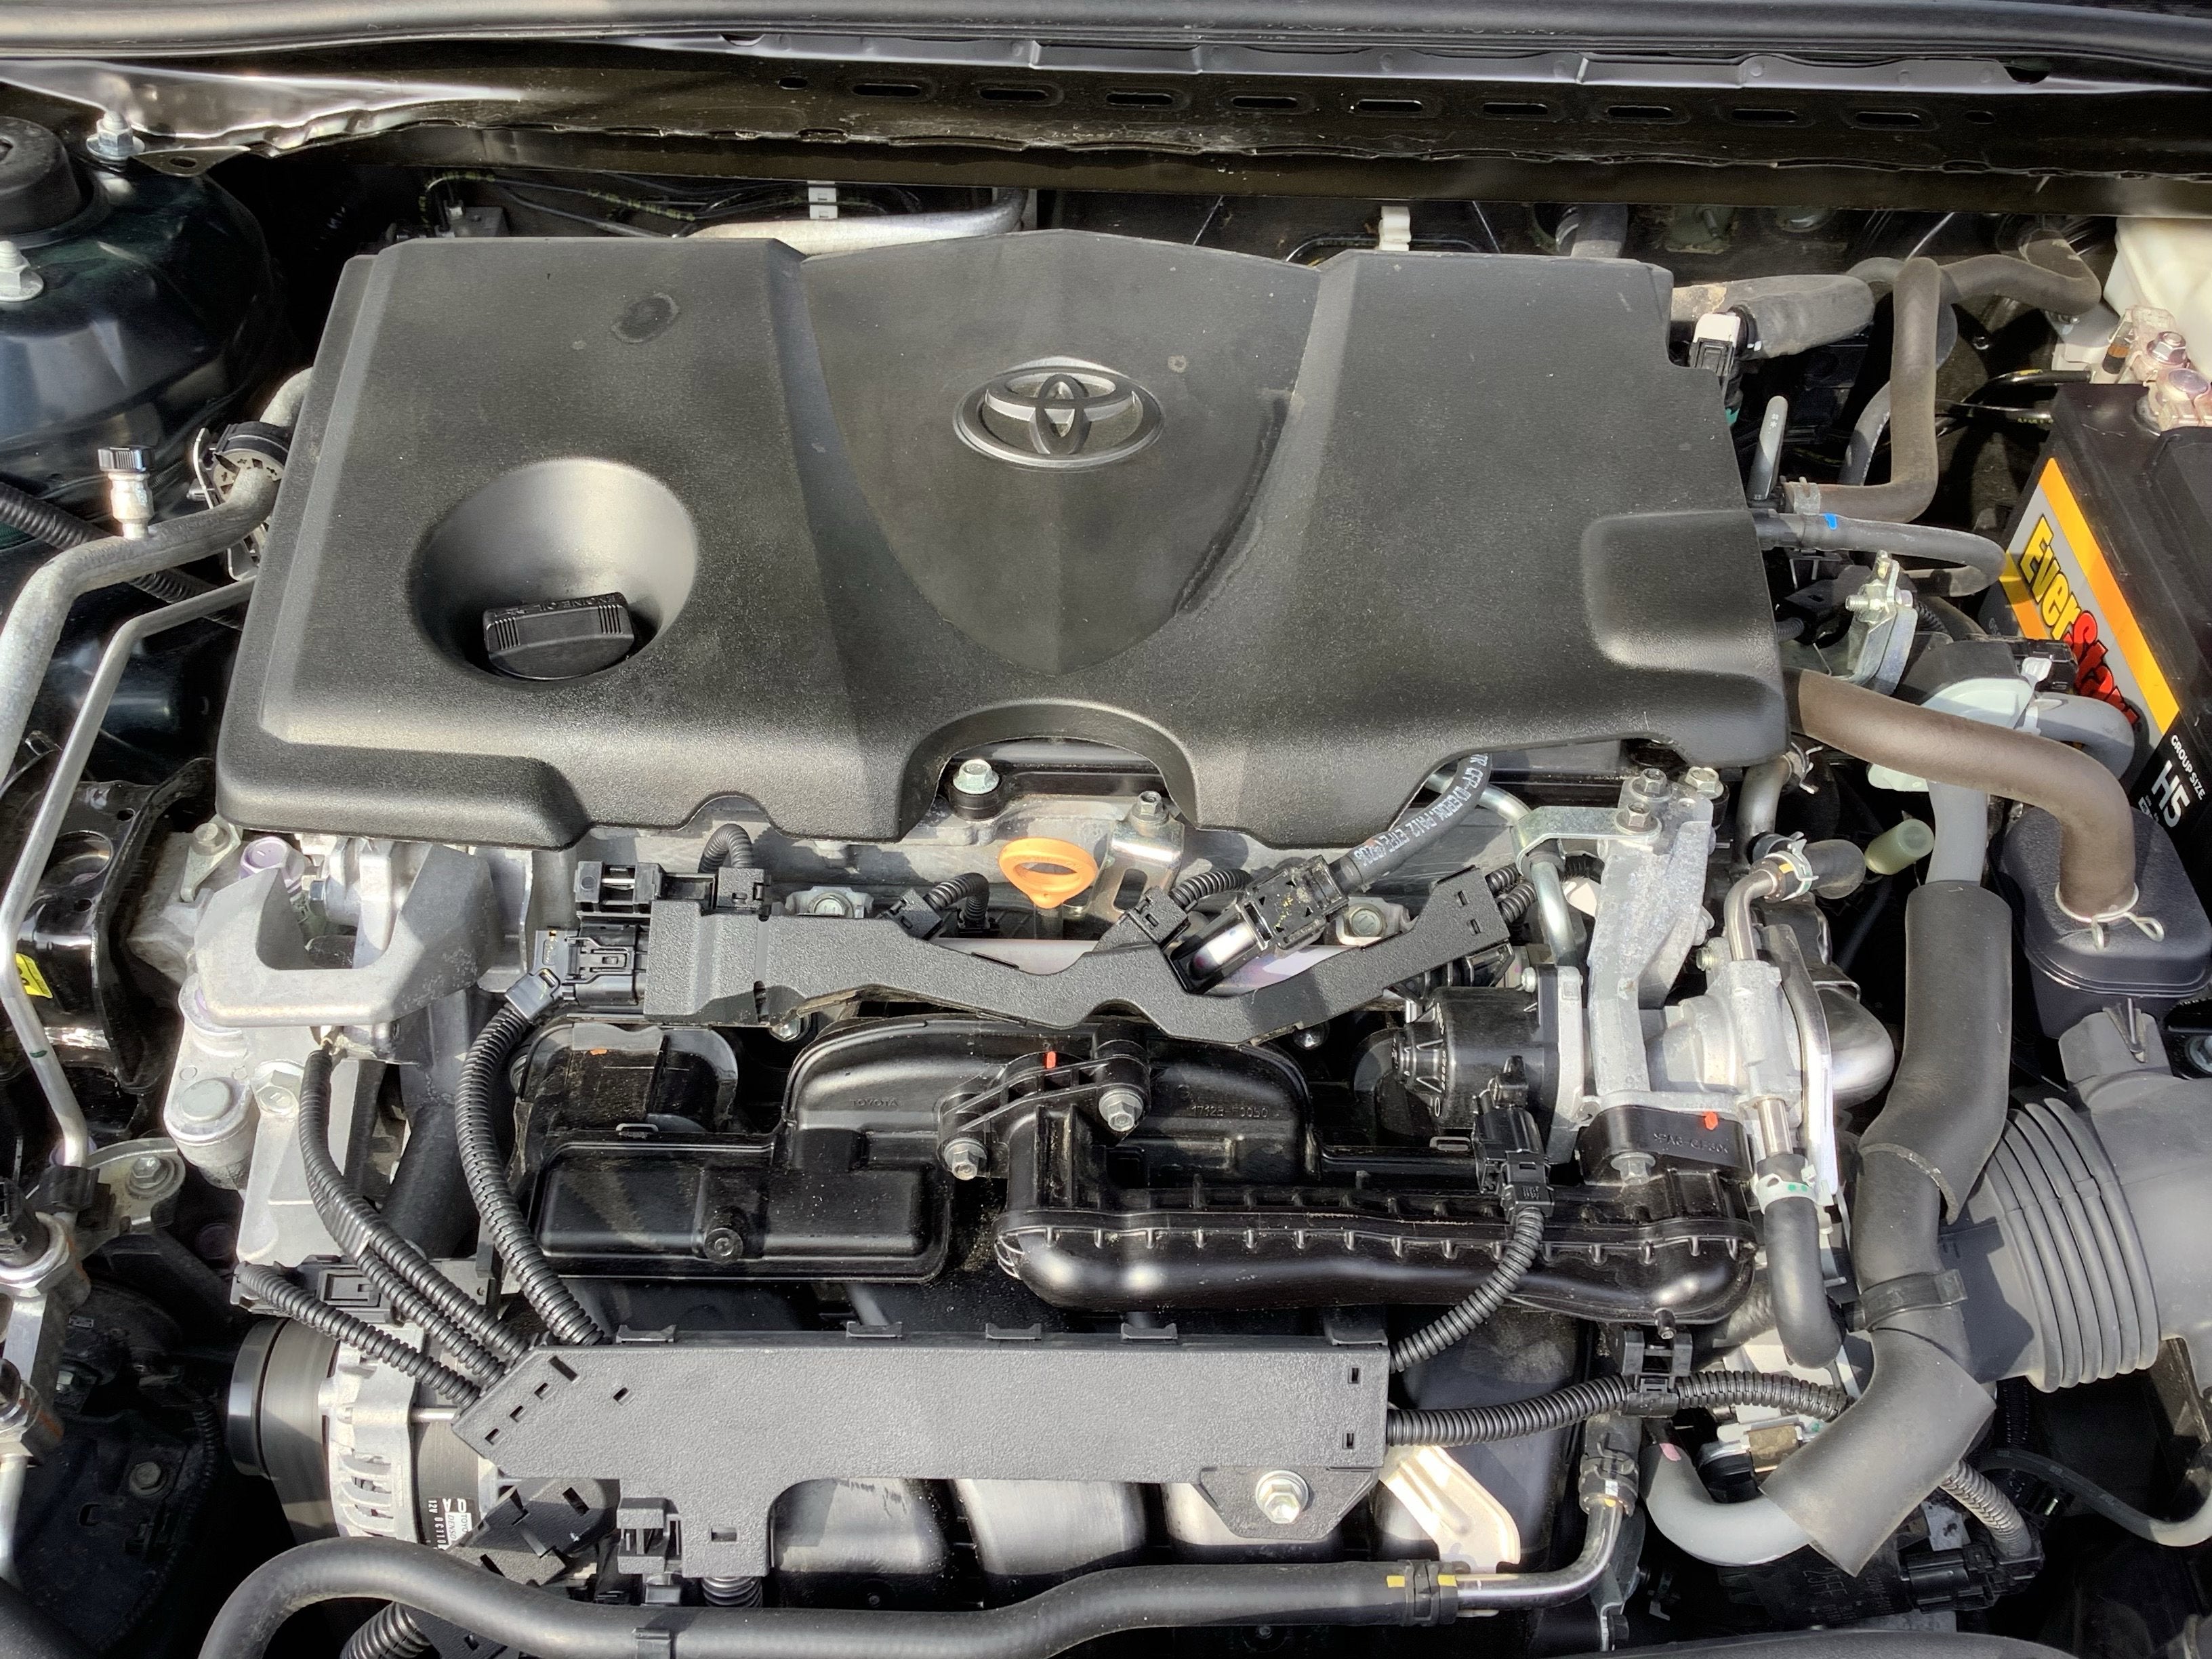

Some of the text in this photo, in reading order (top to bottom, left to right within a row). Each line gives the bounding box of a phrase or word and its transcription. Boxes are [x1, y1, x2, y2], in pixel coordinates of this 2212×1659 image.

[2020, 514, 2139, 725] EverSta
[2171, 735, 2206, 800] GROUP SIZE
[2151, 760, 2190, 827] H5
[849, 1098, 899, 1107] TOYOTA
[428, 1500, 438, 1513] 12V
[448, 1515, 457, 1539] DENSO
